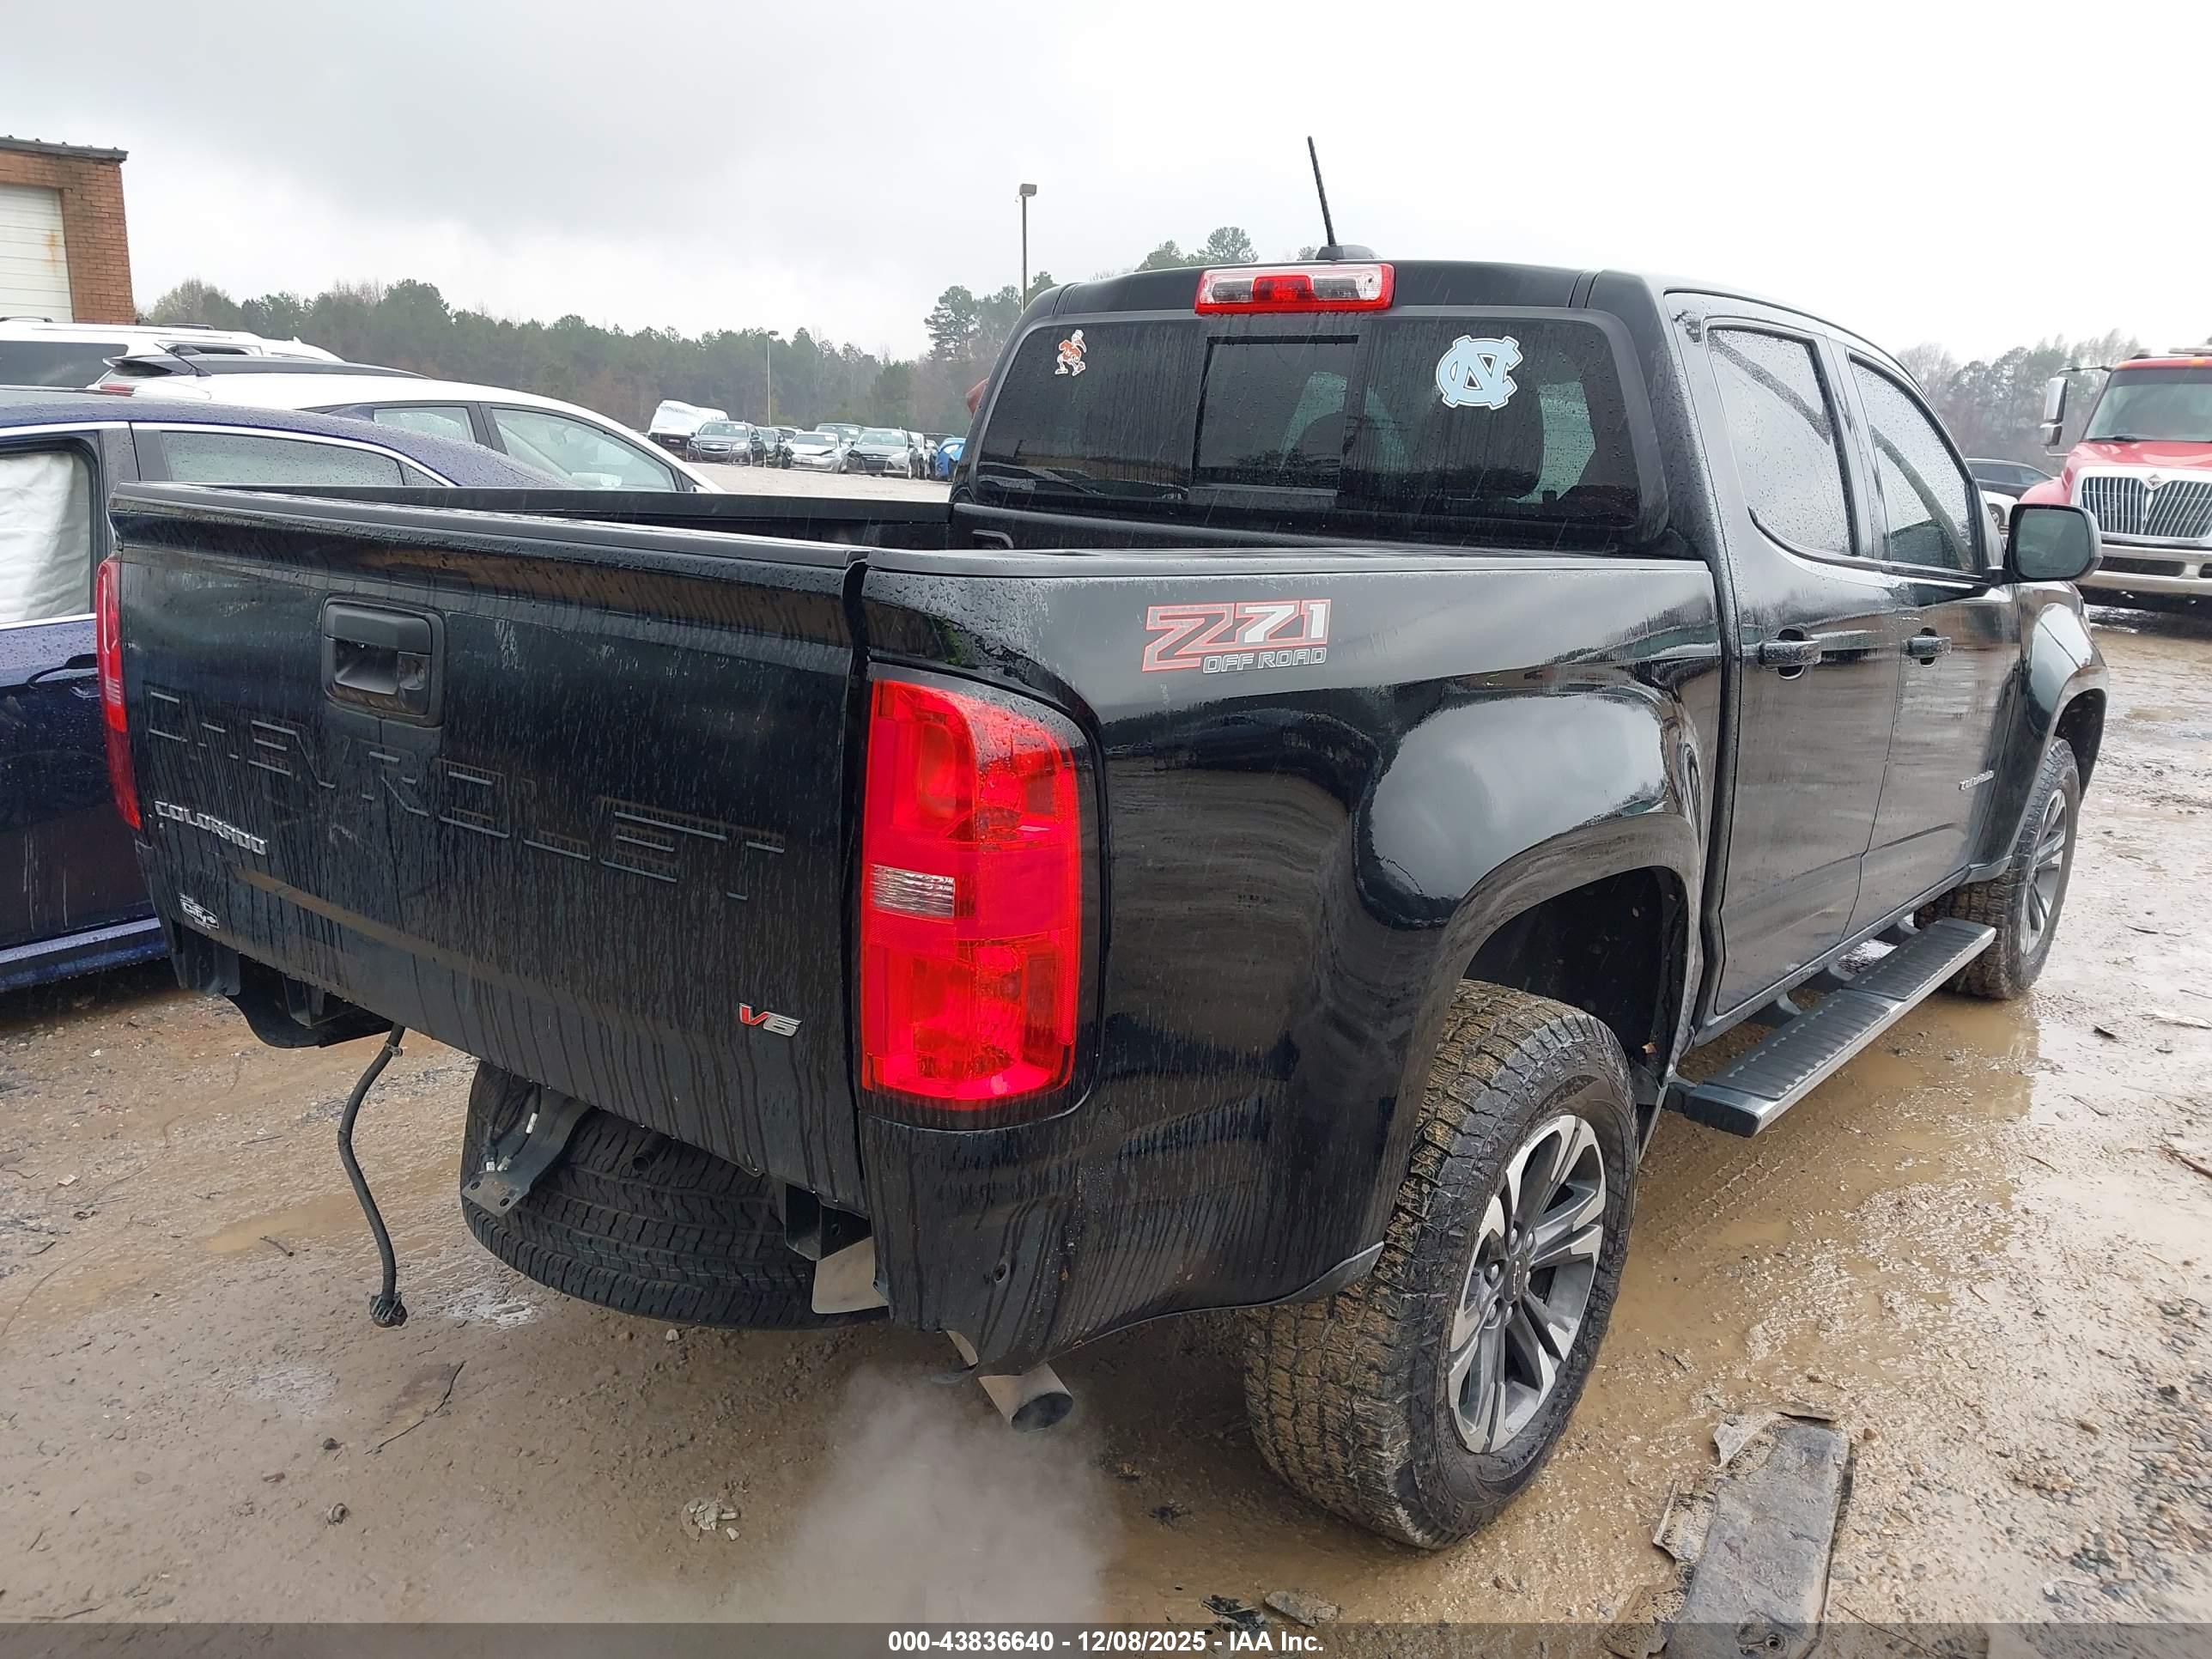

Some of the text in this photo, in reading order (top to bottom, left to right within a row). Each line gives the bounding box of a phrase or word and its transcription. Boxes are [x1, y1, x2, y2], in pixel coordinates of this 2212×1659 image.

[1142, 599, 1332, 672] Z71
[1202, 647, 1328, 674] OFF ROAD
[146, 685, 786, 900] CHEVROLET
[155, 800, 267, 855] COLORADO
[738, 1002, 803, 1037] V6
